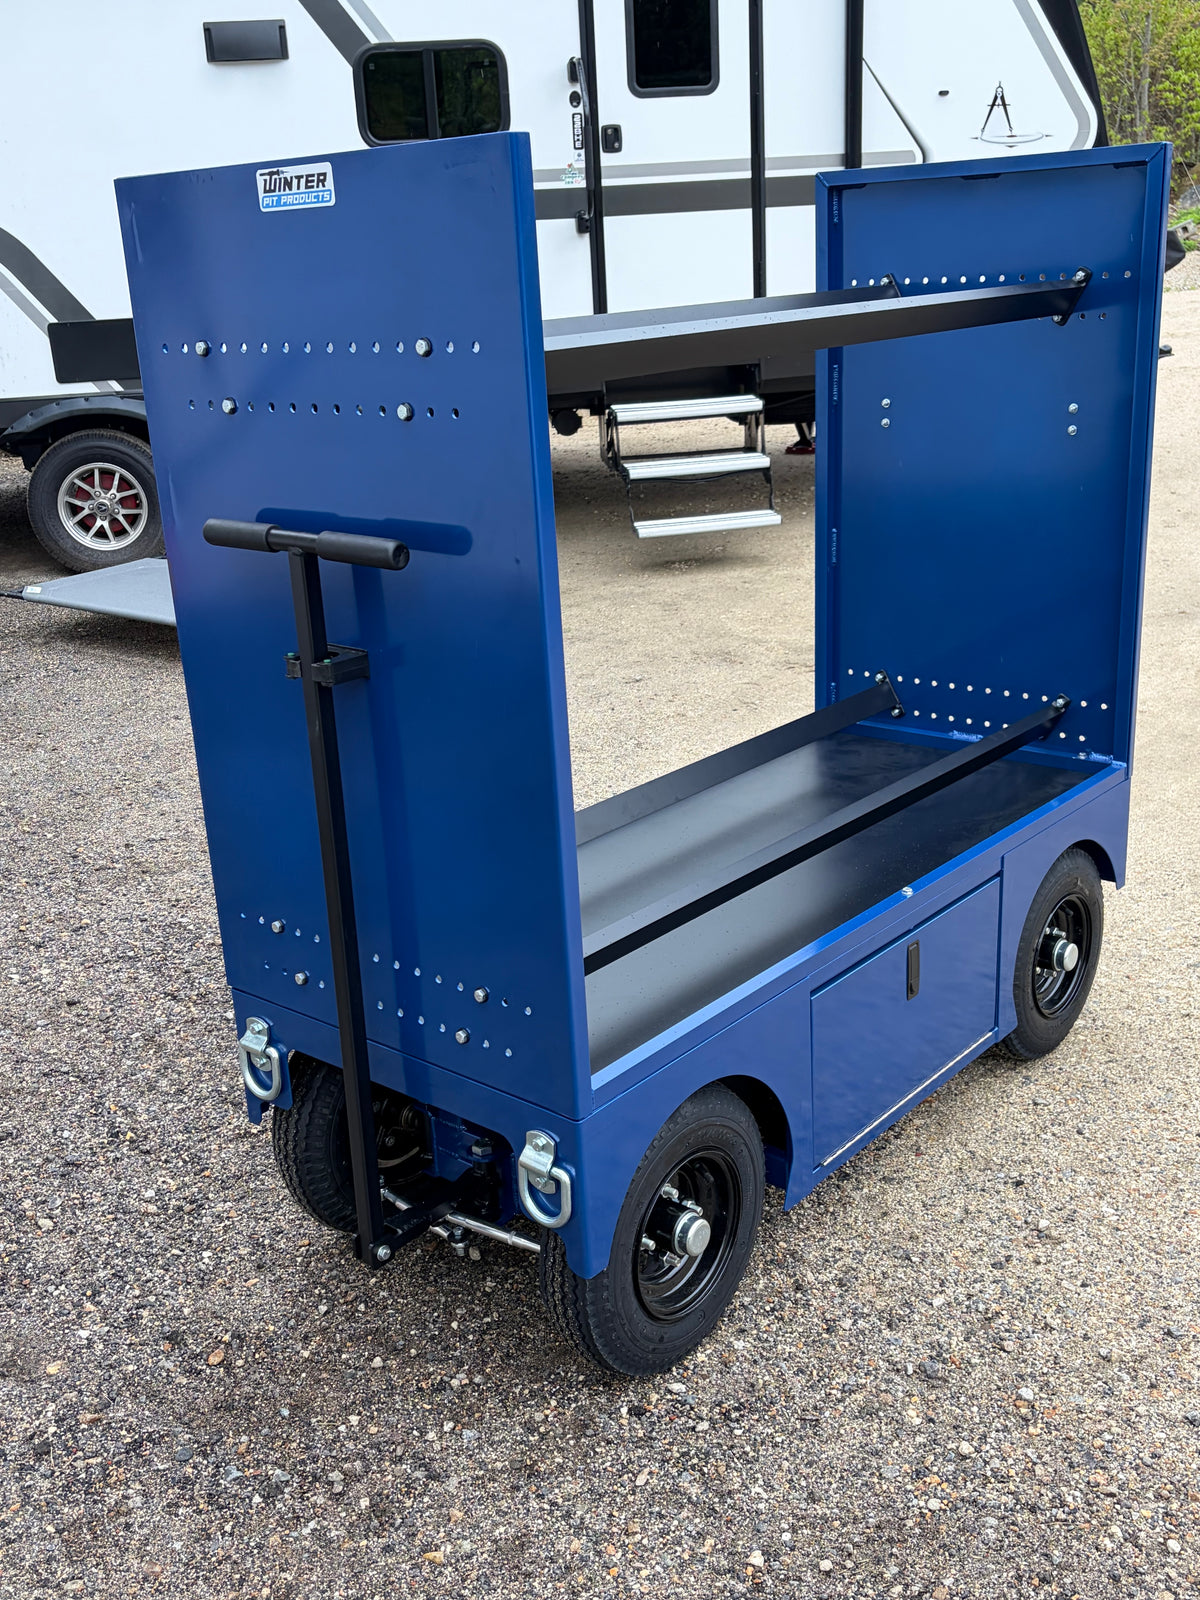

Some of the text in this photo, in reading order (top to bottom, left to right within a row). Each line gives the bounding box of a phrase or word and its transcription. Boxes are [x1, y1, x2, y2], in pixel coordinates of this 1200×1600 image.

[262, 171, 327, 193] WINTER
[263, 191, 330, 206] PIT PRODUCTS
